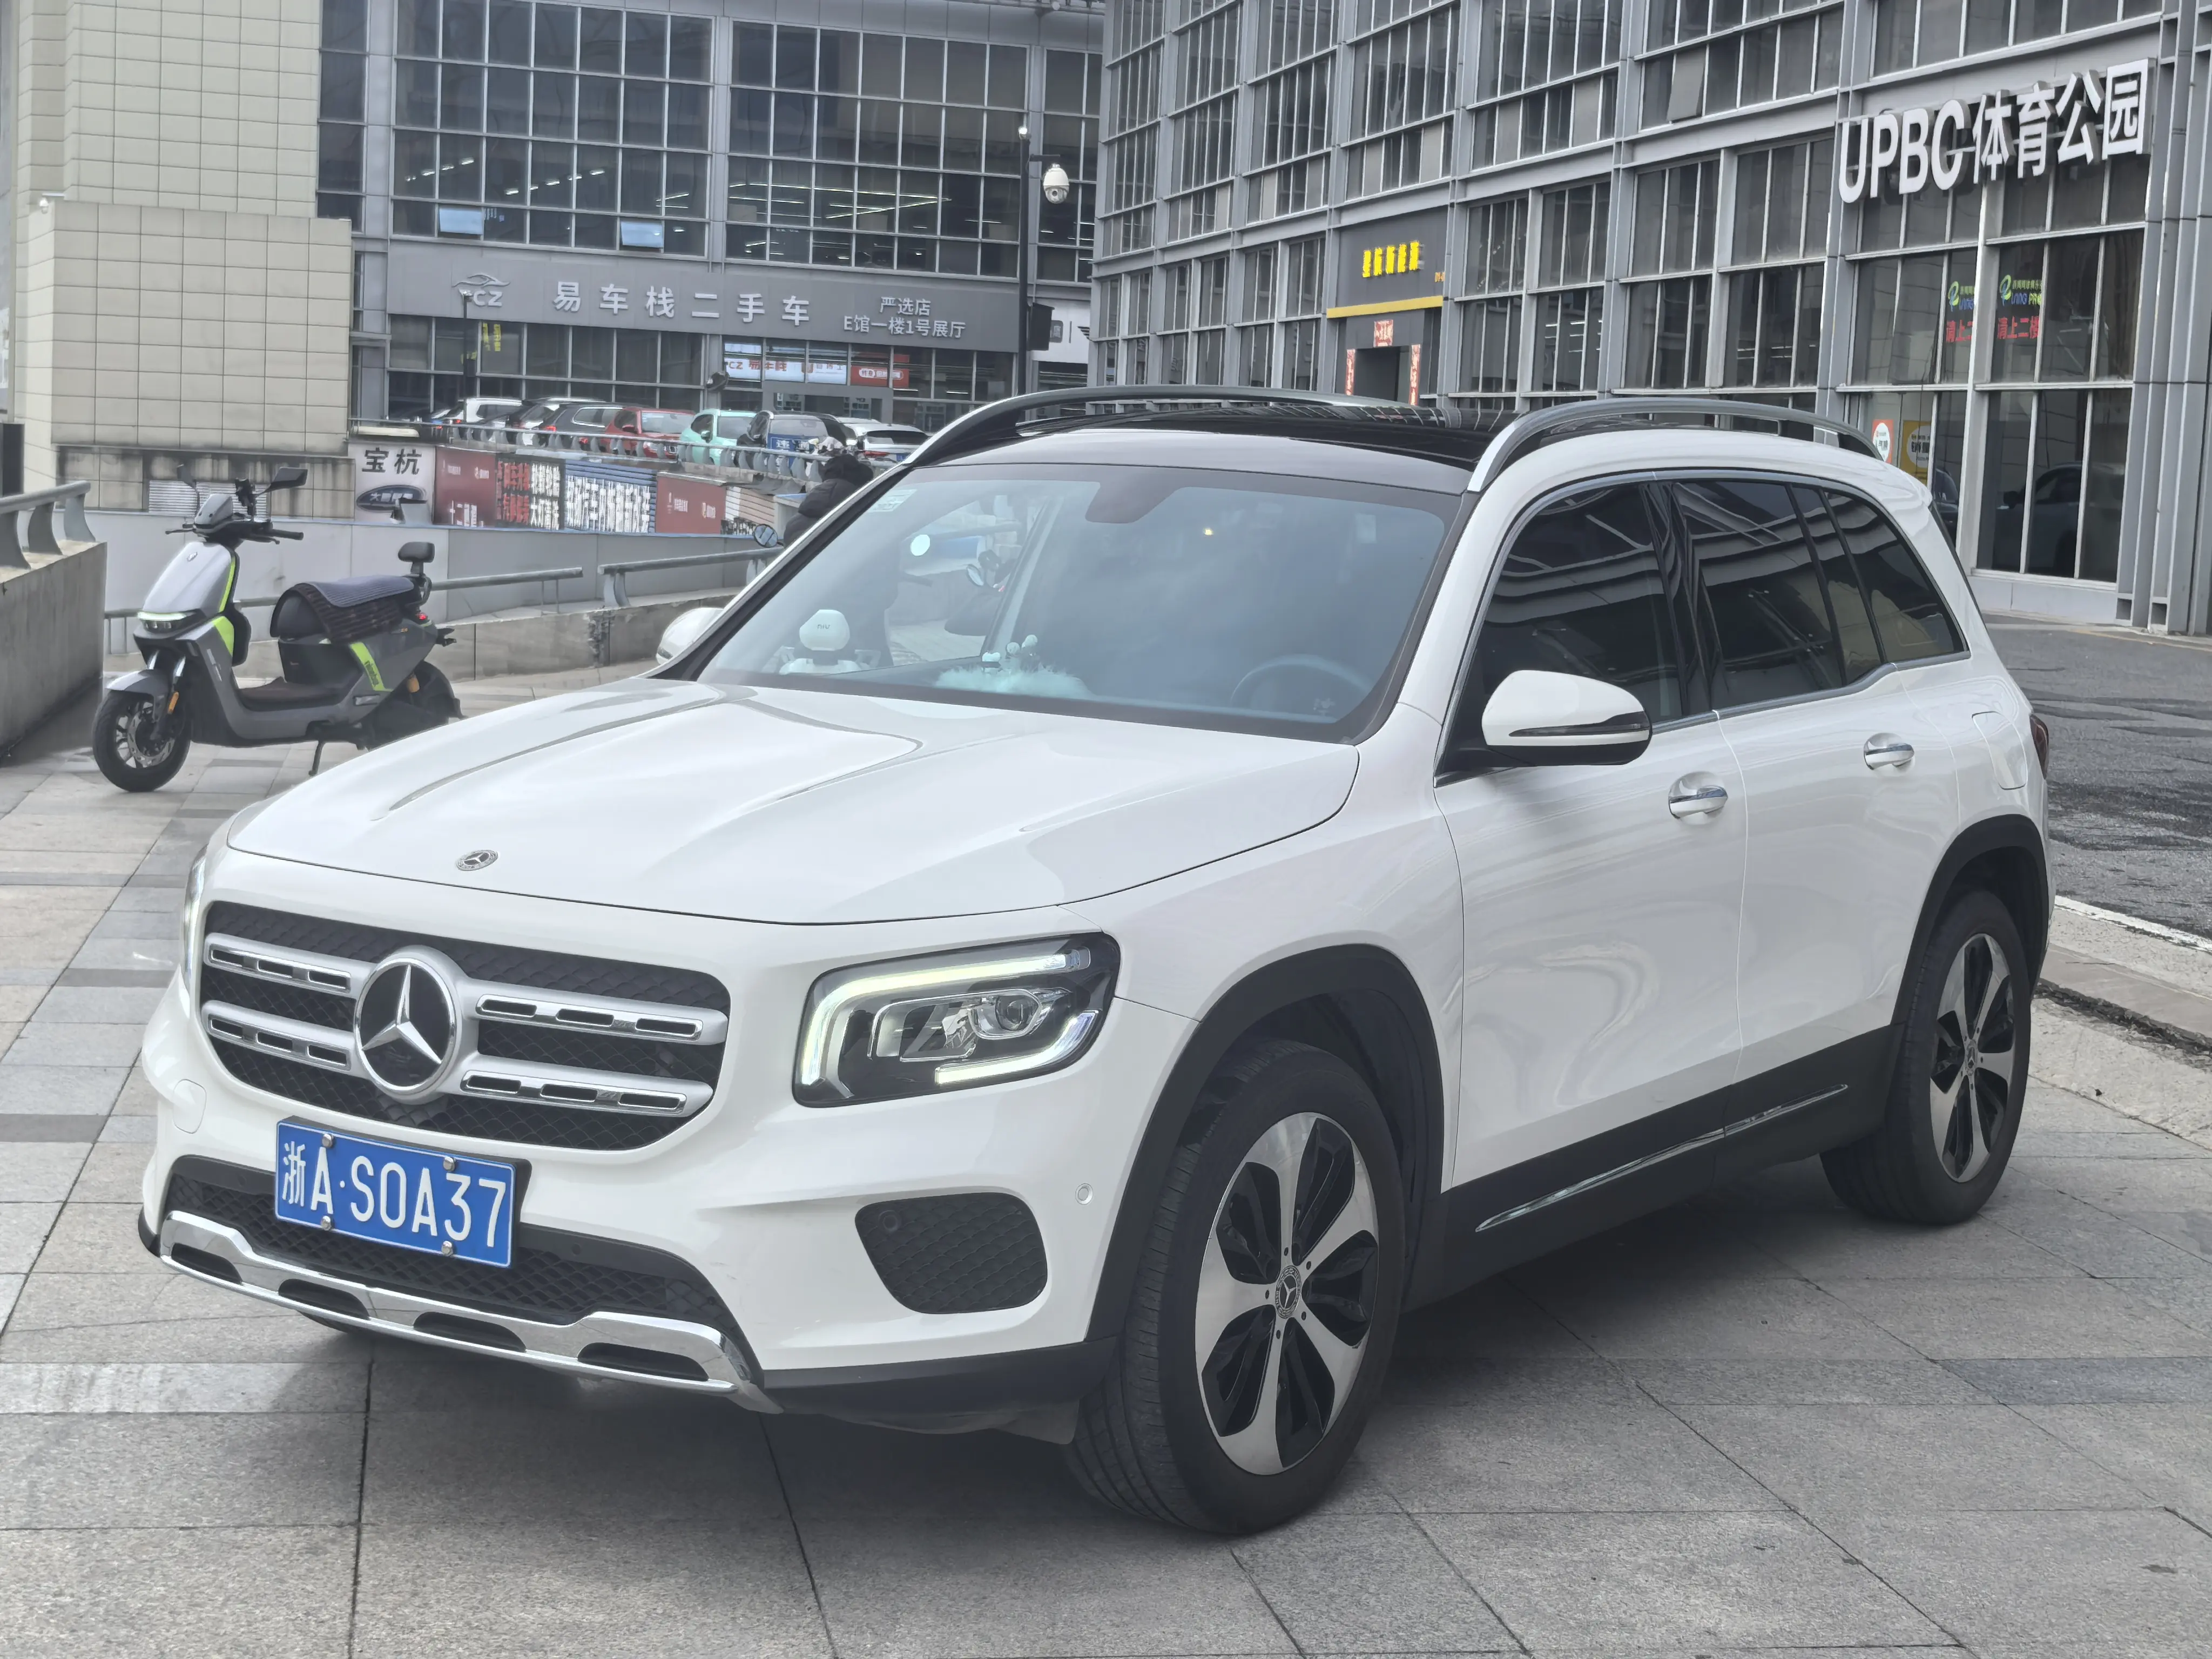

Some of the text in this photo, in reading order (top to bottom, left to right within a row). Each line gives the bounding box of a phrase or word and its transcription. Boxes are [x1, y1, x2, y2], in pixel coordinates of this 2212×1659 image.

[1838, 58, 2155, 203] UPBC体育公园
[553, 281, 810, 326] 易车栈二手车
[879, 296, 931, 316] 严选店
[844, 315, 966, 339] E馆一楼1号展厅
[362, 447, 422, 475] 宝杭
